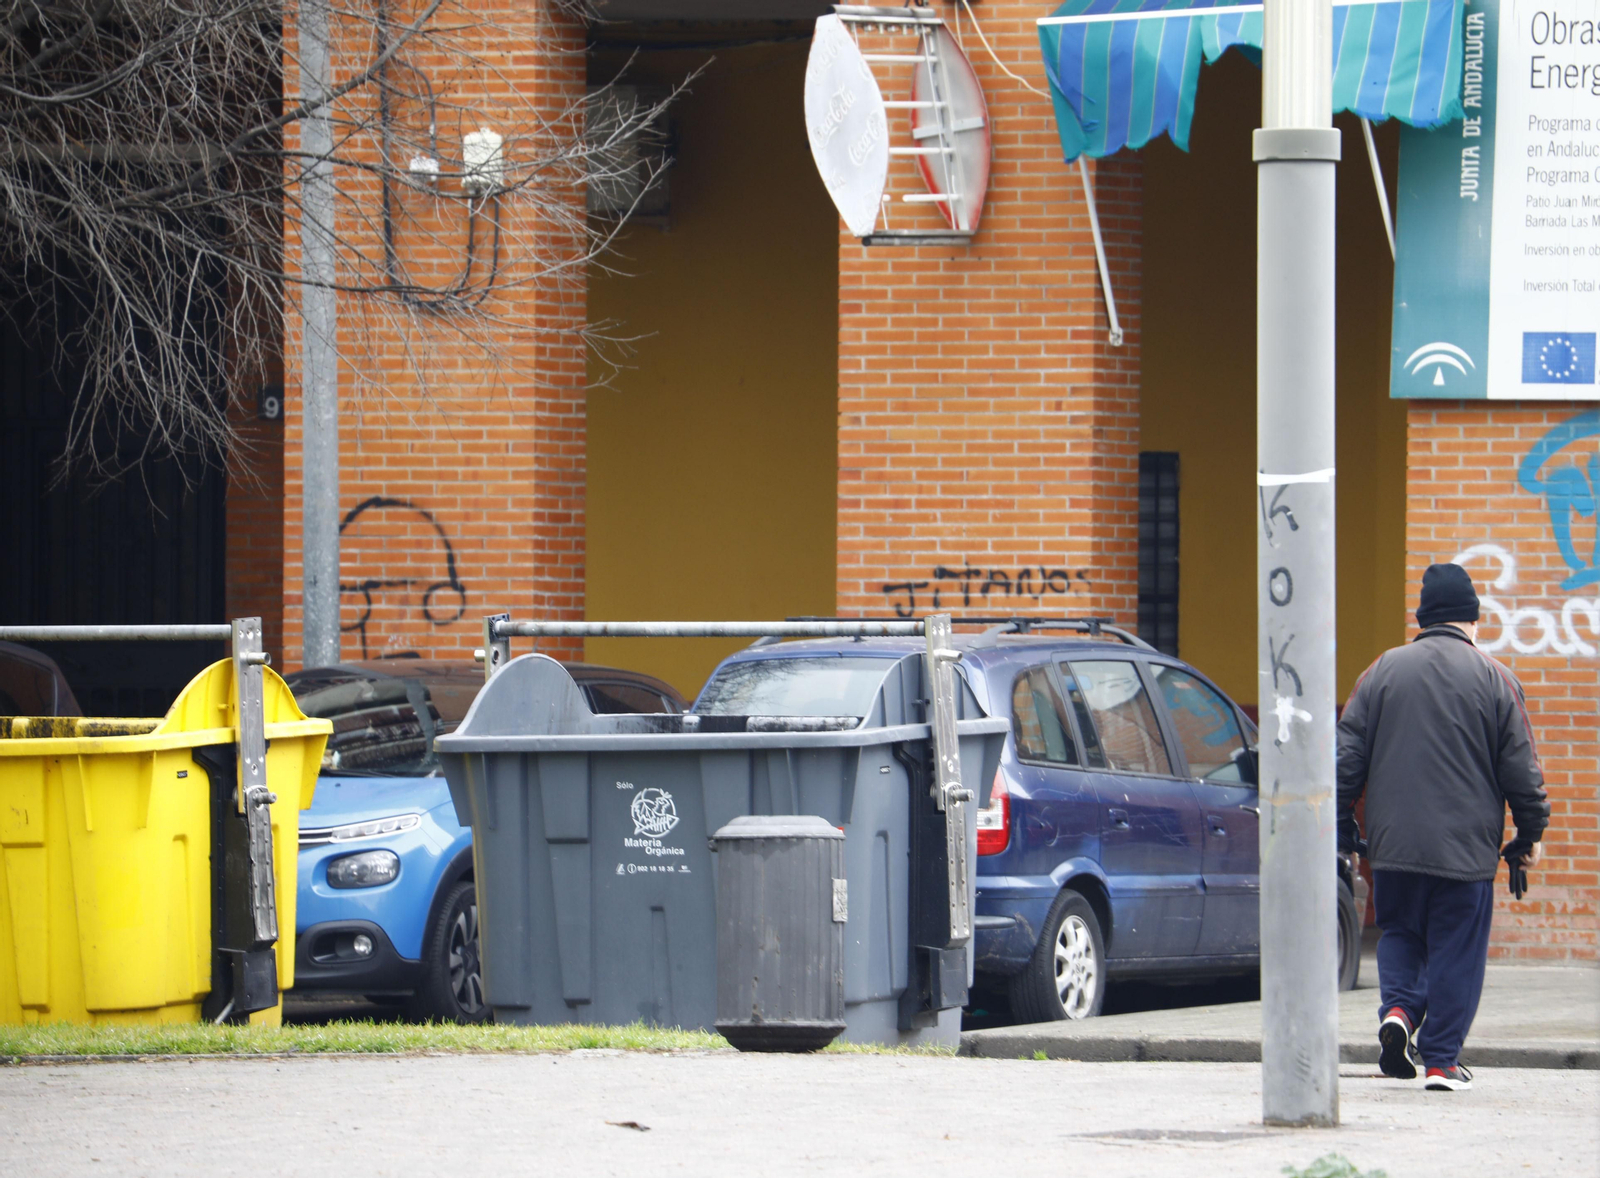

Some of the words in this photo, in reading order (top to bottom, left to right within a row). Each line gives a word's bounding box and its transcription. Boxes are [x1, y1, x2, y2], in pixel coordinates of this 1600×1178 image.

[1531, 11, 1600, 45] Obra
[1463, 12, 1485, 108] ANDALUCIA
[1530, 55, 1600, 96] Energ
[1462, 115, 1482, 138] DE
[1528, 114, 1591, 135] Programa
[1526, 144, 1543, 157] en
[1547, 140, 1600, 157] Andaluc
[1460, 145, 1481, 201] JUNTA
[1526, 166, 1589, 187] Programa
[1526, 194, 1551, 208] Patio
[1554, 194, 1578, 208] Juan
[1525, 214, 1567, 228] Barriada
[1571, 214, 1589, 228] Las
[1524, 242, 1570, 257] Inversión
[1573, 245, 1585, 257] en
[1523, 278, 1569, 292] Inversión
[1572, 278, 1595, 292] Total
[265, 396, 279, 418] 9
[624, 837, 662, 848] Materia
[645, 846, 685, 857] Orgánica
